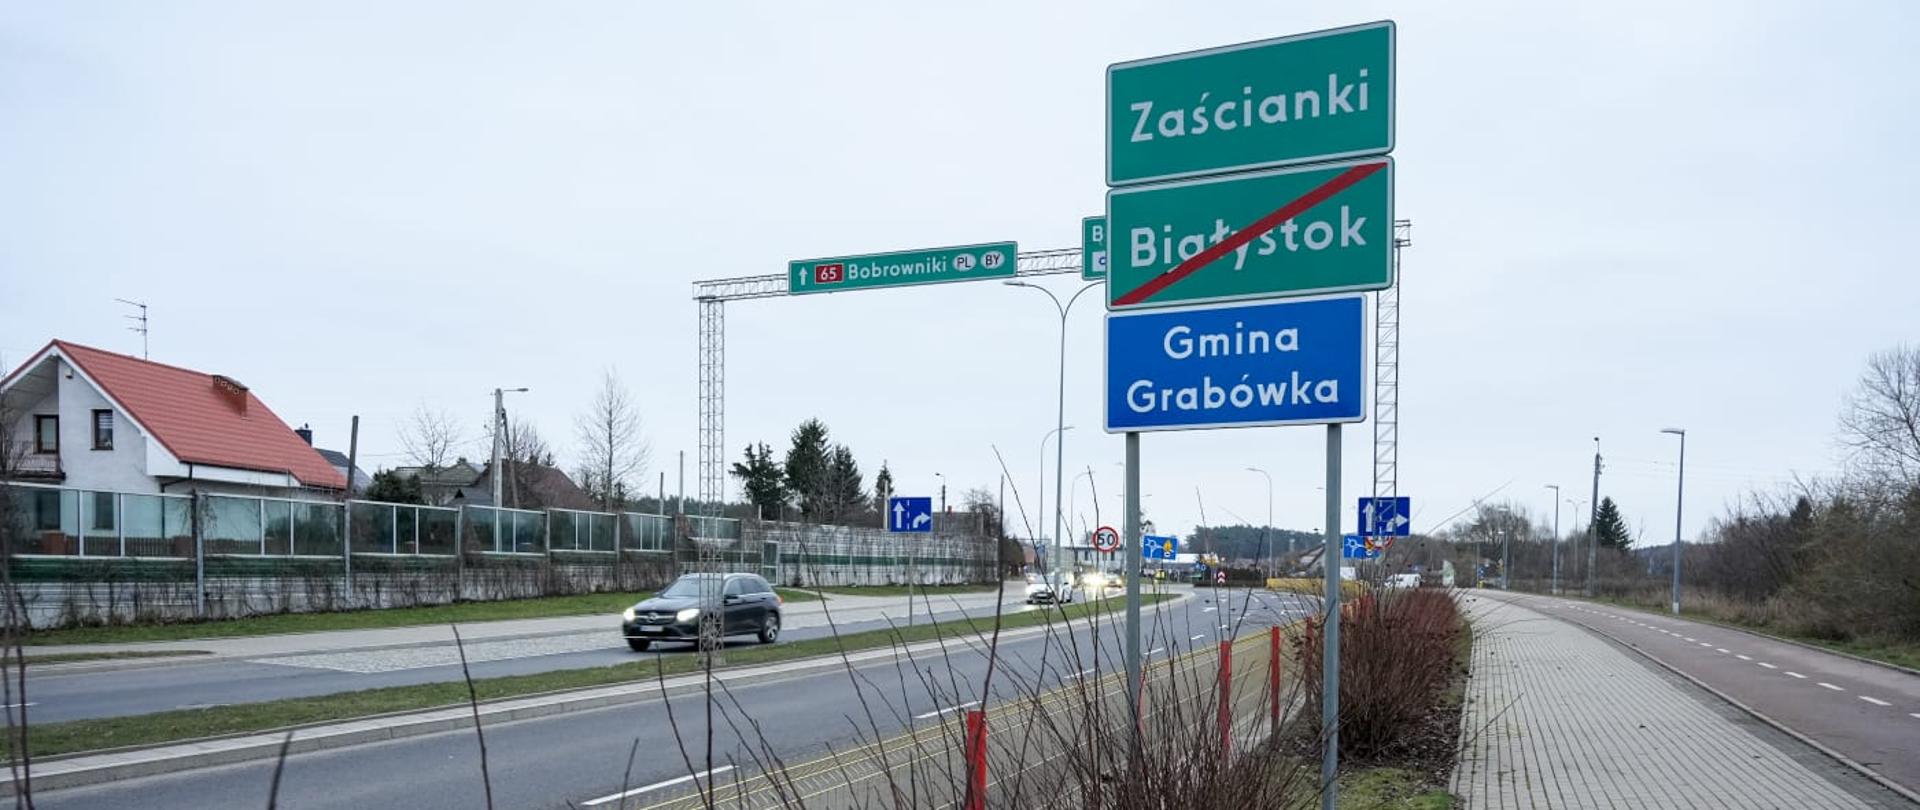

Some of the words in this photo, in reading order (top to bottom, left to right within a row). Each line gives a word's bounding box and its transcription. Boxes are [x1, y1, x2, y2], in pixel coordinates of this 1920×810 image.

[1130, 69, 1369, 142] Zaścianki
[1131, 206, 1366, 271] Białystok
[820, 266, 837, 280] 65
[849, 257, 947, 279] Bobrowniki
[956, 257, 971, 269] PL
[985, 253, 1001, 266] BY
[1163, 321, 1299, 359] Gmina
[1126, 371, 1339, 413] Grabówka
[1097, 533, 1115, 545] 50
